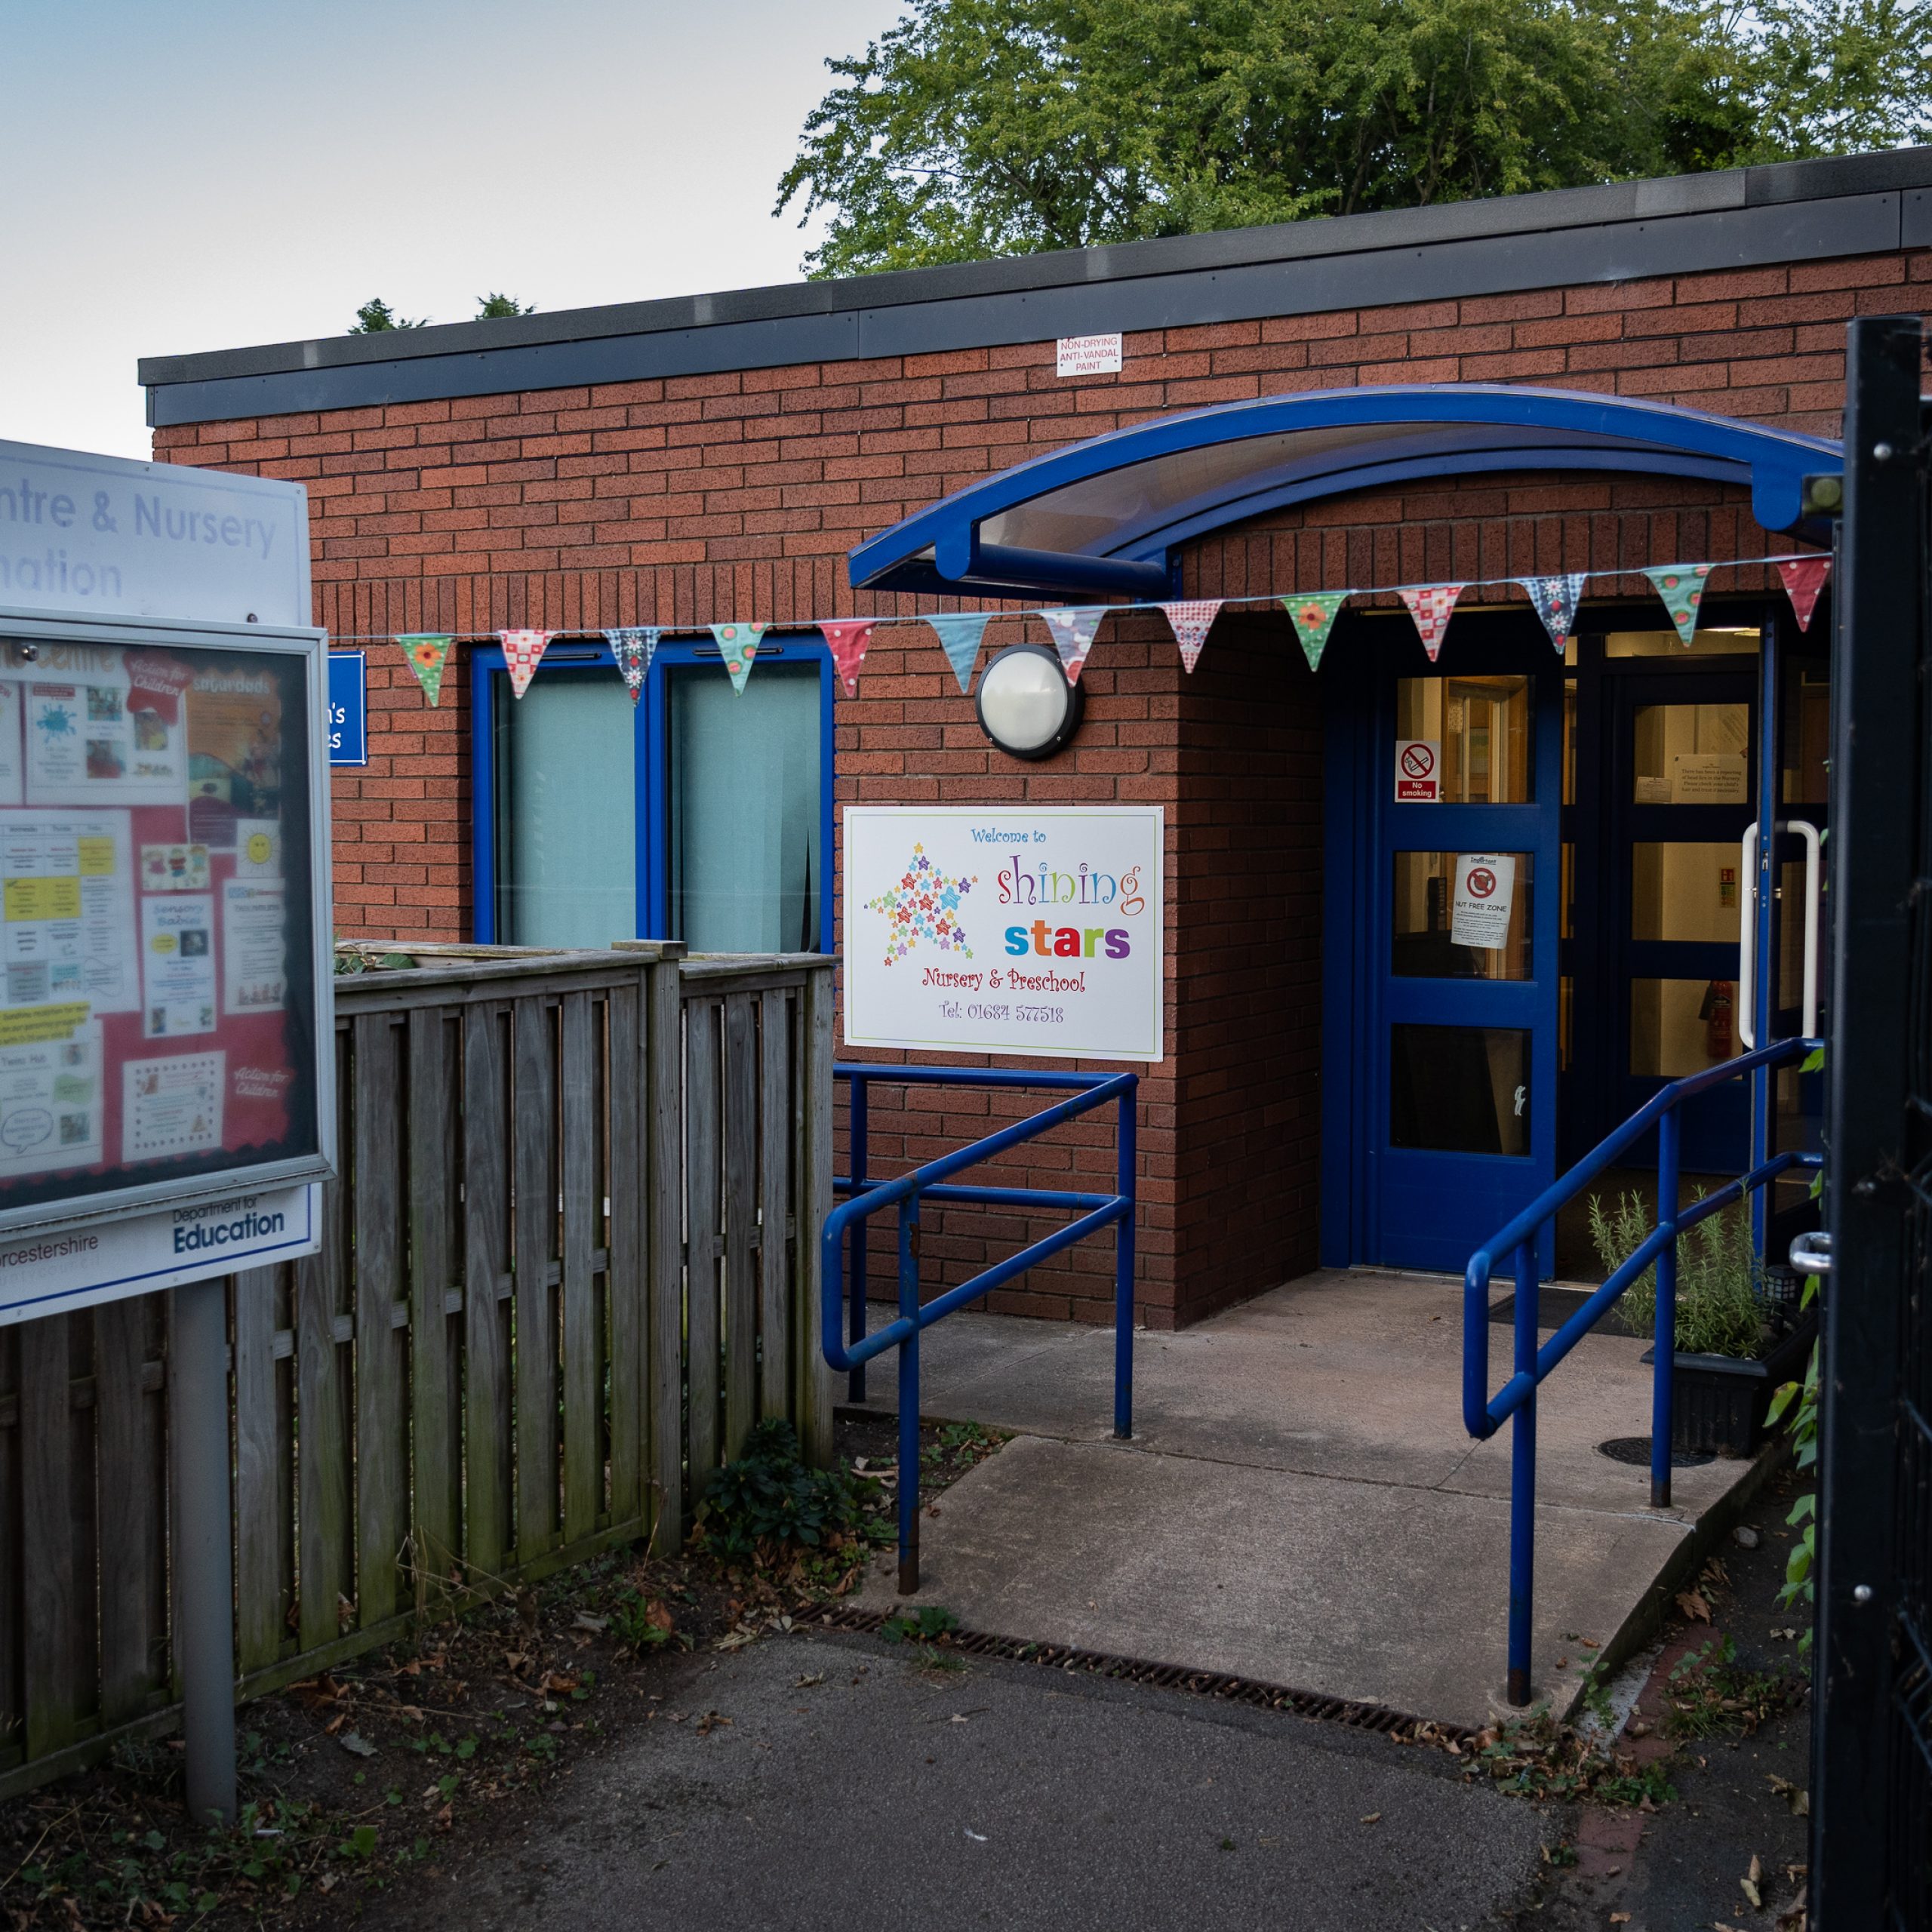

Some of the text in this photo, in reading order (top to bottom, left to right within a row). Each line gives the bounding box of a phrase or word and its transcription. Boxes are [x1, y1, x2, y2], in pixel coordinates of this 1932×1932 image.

[1061, 337, 1118, 350] NON-DRYING
[1060, 349, 1118, 361] ANTI-VANDAL
[1075, 361, 1102, 371] PAINT
[92, 491, 118, 534] &
[134, 494, 277, 560] Nursery
[131, 658, 168, 679] Action
[134, 675, 180, 696] Children
[1402, 789, 1432, 798] smoking
[971, 827, 1046, 844] Welcome to
[997, 854, 1146, 916] shining
[1469, 902, 1484, 910] FREE
[1487, 904, 1508, 912] ZONE
[1004, 919, 1131, 959] stars
[922, 968, 1086, 993] Nursery & Preschool
[938, 1000, 1064, 1023] Tel: 01684 577518
[234, 1066, 290, 1084] Action for
[235, 1082, 278, 1097] Children
[173, 1196, 257, 1224] Department for
[174, 1211, 285, 1254] Education
